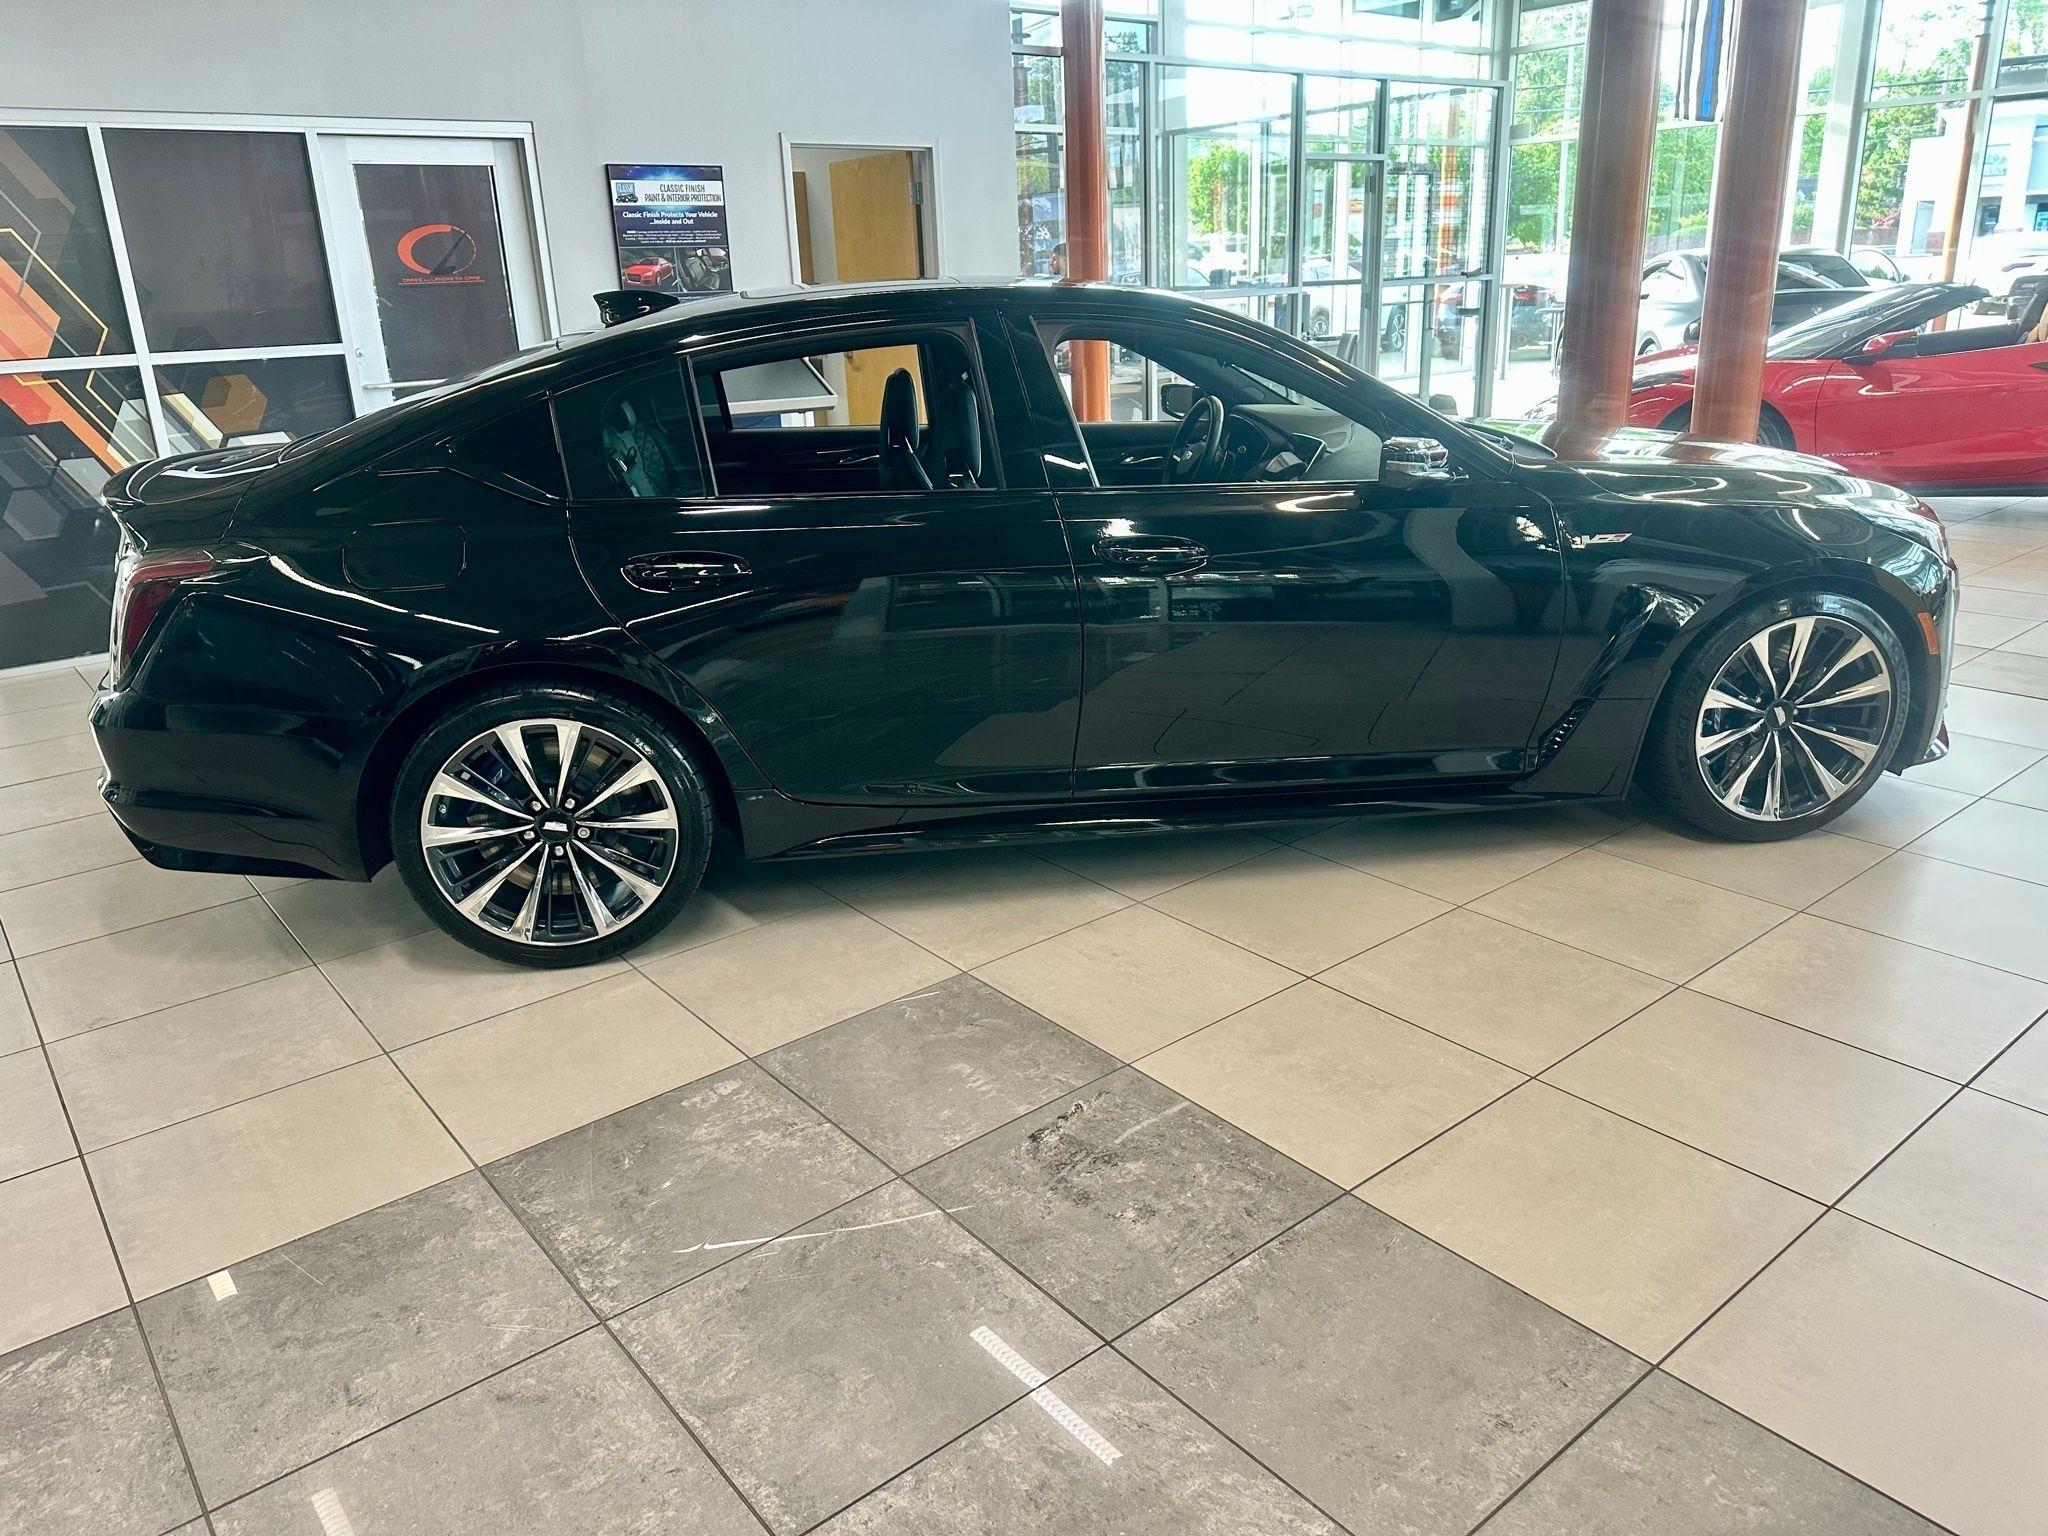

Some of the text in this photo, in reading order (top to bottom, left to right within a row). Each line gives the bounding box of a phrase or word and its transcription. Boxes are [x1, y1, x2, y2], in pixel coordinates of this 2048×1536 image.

[659, 184, 705, 193] CLASSIC FINISH
[644, 193, 722, 202] PAINT & INTERIOR PROTECTION
